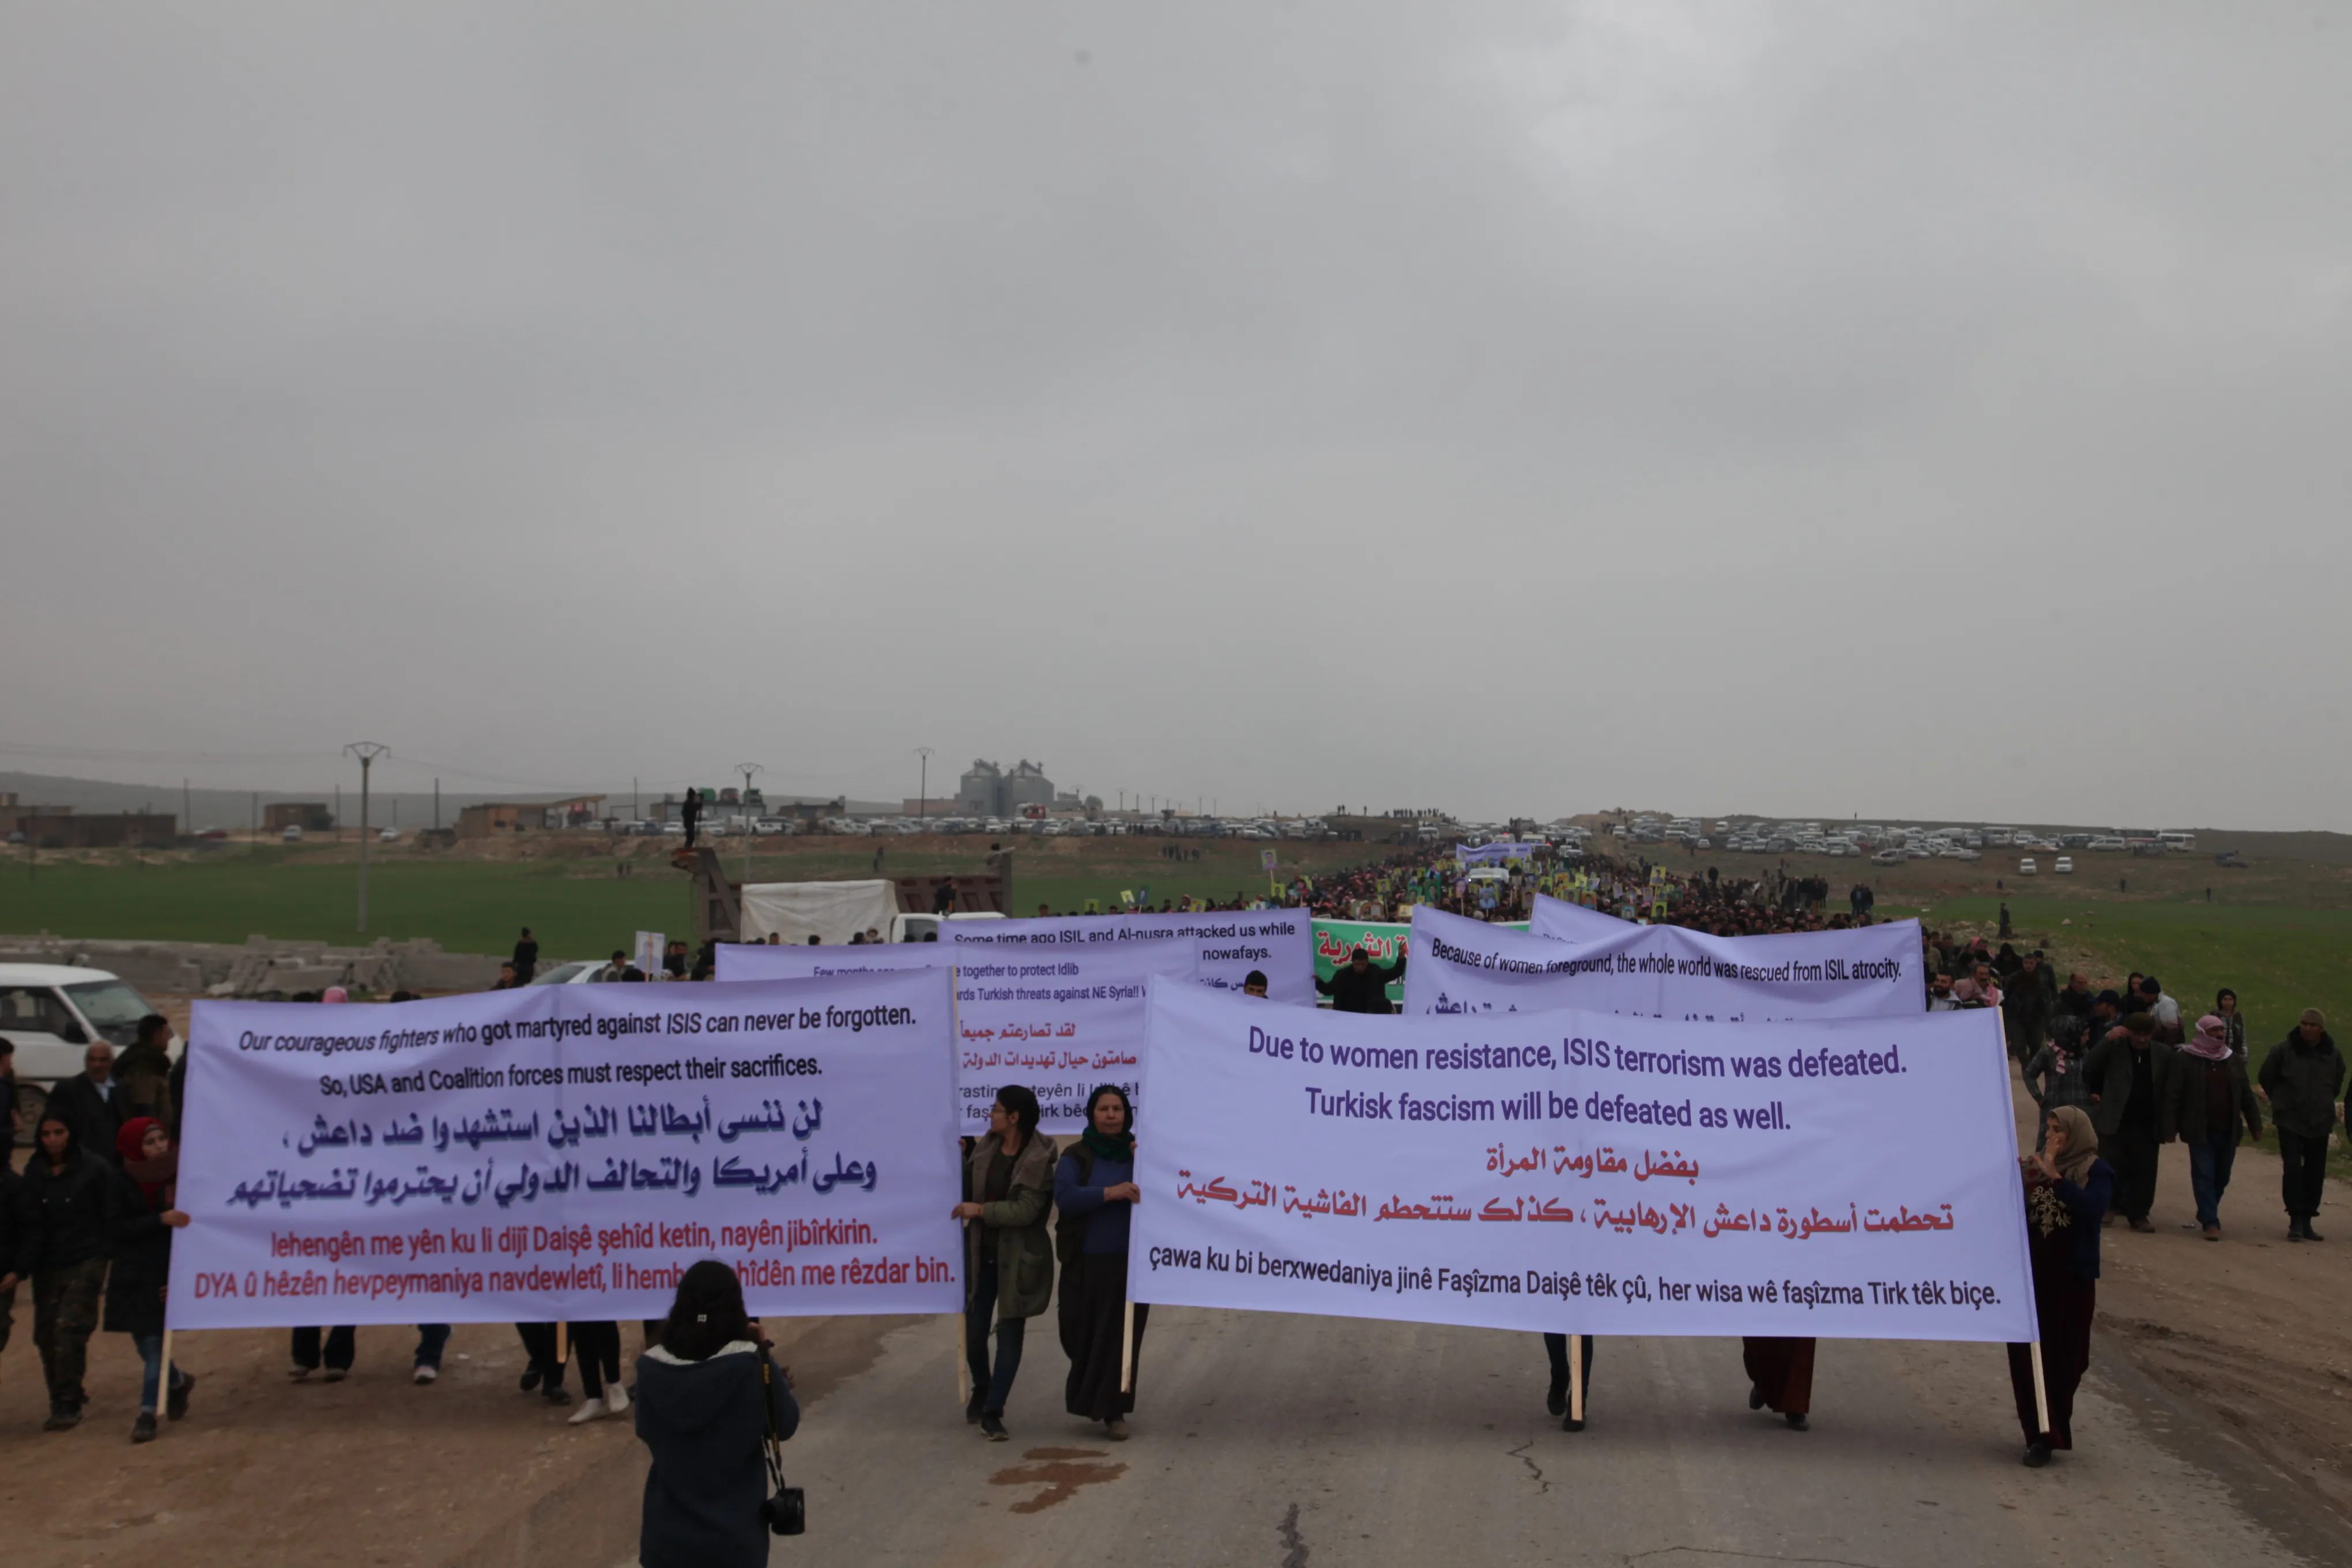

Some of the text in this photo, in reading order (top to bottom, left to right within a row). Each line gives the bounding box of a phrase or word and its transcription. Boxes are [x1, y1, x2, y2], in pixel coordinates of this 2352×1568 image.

[1060, 930, 1085, 943] ISIL
[1089, 929, 1113, 941] and
[1177, 924, 1235, 938] attacked
[1239, 926, 1256, 936] us
[1260, 922, 1295, 935] while
[963, 963, 1005, 979] together
[1008, 965, 1018, 977] to
[1020, 963, 1056, 979] protect
[1058, 962, 1079, 975] Idlib
[1203, 945, 1272, 962] nowafays.
[1432, 938, 1482, 967] Because
[1484, 952, 1499, 968] of
[1499, 958, 1543, 974] women
[1547, 953, 1615, 975] foreground,
[1617, 953, 1635, 973] the
[1639, 952, 1675, 974] whole
[1678, 956, 1712, 977] world
[1713, 962, 1738, 978] was
[1741, 961, 1790, 981] rescued
[1793, 960, 1822, 981] from
[1825, 959, 1849, 980] ISIL
[1852, 957, 1902, 982] atrocity.
[977, 987, 1014, 1001] Turkish
[1016, 987, 1051, 1000] threats
[1053, 986, 1090, 1002] against
[1092, 986, 1107, 998] NE
[1109, 985, 1139, 1001] Syria!!
[239, 1005, 916, 1057] Our courageous fighters who got martyred against ISIS can never be forgotten.
[998, 1023, 1051, 1041] تصارعتم
[1056, 1023, 1076, 1037] لقد
[962, 1050, 1137, 1071] صامتون حيال تهديدات الدولة
[1249, 1026, 1906, 1078] Due to women resistance, ISIS terrorism was defeated.
[319, 1053, 823, 1098] So, USA and Coalition forces must respect their sacrifices.
[383, 1112, 424, 1145] ضد
[548, 1104, 617, 1149] الذين
[628, 1095, 711, 1144] أبطالنا
[718, 1099, 786, 1143] ننسى
[793, 1097, 823, 1141] لن
[1305, 1087, 1791, 1130] Turkisk fascism will be defeated as well.
[297, 1114, 372, 1158] داعش
[433, 1109, 539, 1152] استشهدوا
[226, 1147, 877, 1208] وعلى أمريكا والتحالف الدولي أن يحترموا تضحياتهم
[1486, 1143, 1699, 1186] بفضل مقاومة المرأة
[1178, 1169, 1276, 1209] التركية
[1283, 1185, 1366, 1219] الفاشية
[1373, 1194, 1471, 1222] ستتحطم
[1477, 1195, 1573, 1222] كذلك
[1594, 1198, 1695, 1235] الإرهابية
[1703, 1203, 1771, 1238] داعش
[1776, 1202, 1857, 1239] أسطورة
[1864, 1204, 1954, 1234] تحطمت
[371, 1235, 404, 1255] me
[408, 1228, 445, 1260] yên
[451, 1227, 475, 1253] ku
[482, 1227, 492, 1252] li
[498, 1226, 529, 1258] dijî
[533, 1224, 592, 1256] Daişê
[598, 1222, 654, 1256] şehîd
[659, 1222, 715, 1250] ketin,
[721, 1219, 783, 1252] nayên
[787, 1218, 877, 1253] jibîrkirin.
[194, 1272, 238, 1299] DYA
[263, 1271, 327, 1296] hêzên
[334, 1268, 483, 1301] hevpeymaniya
[491, 1264, 606, 1293] navdewletî,
[613, 1262, 623, 1289] li
[802, 1265, 835, 1286] me
[842, 1256, 910, 1284] rêzdar
[915, 1256, 955, 1283] bin.
[1149, 1246, 2001, 1311] çawa ku bi berxwedaniya jinê Faşîzma Daişê têk çû, her wisa wê faşîzma Tirk têk biçe.
